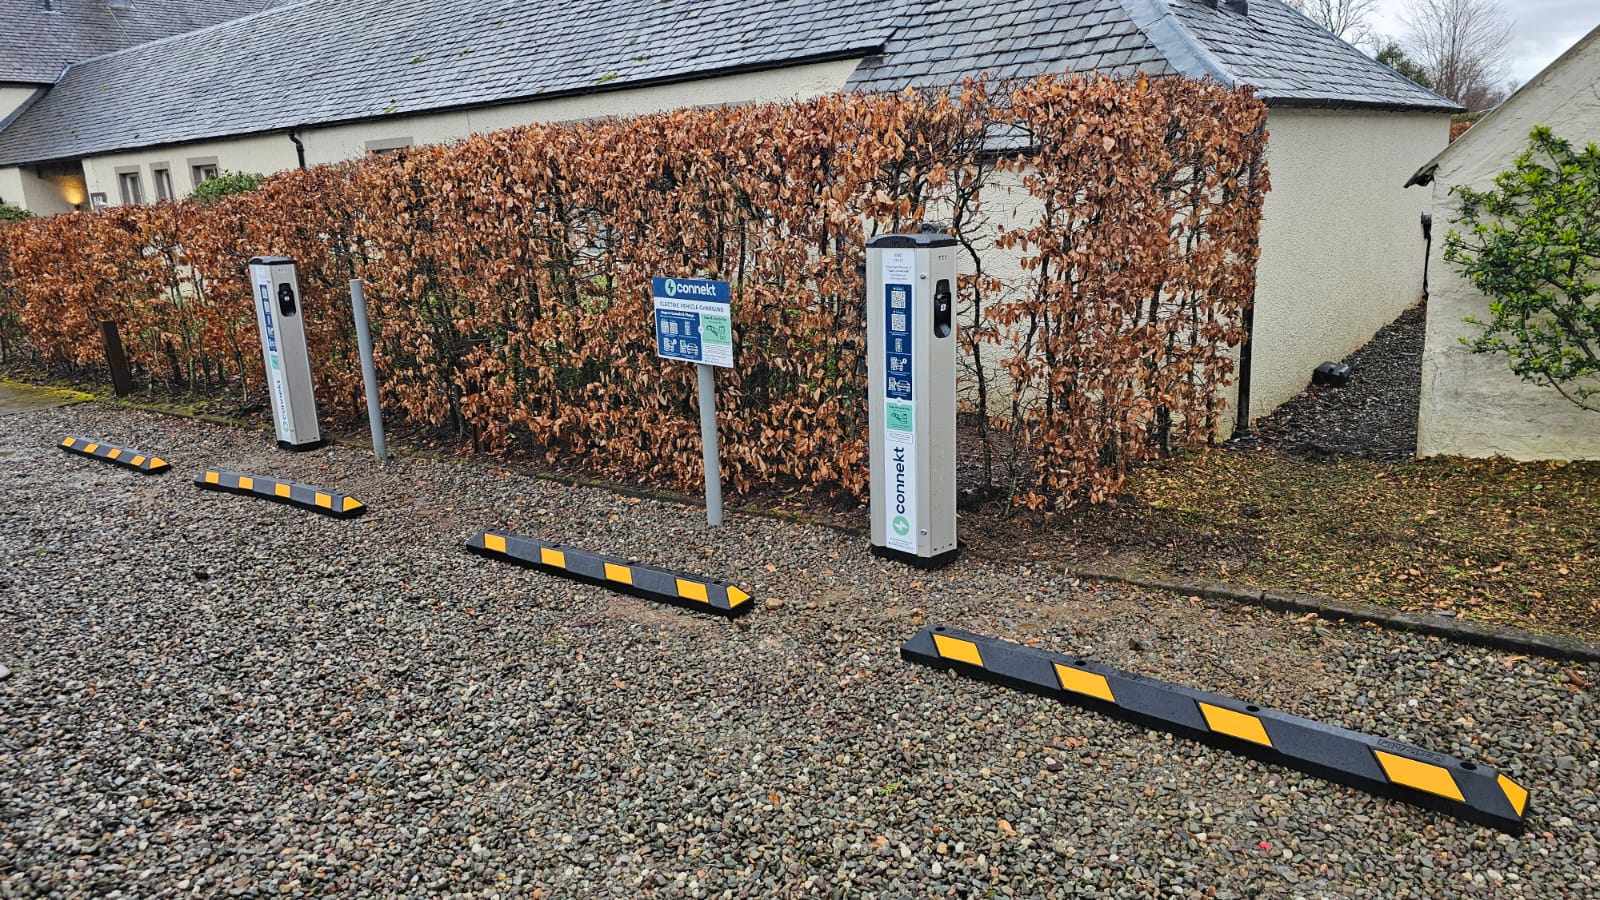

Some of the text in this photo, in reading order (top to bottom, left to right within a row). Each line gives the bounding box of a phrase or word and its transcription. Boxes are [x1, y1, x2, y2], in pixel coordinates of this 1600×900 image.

[677, 283, 716, 296] connekt
[699, 304, 724, 313] CHARGING
[893, 446, 905, 514] connekt
